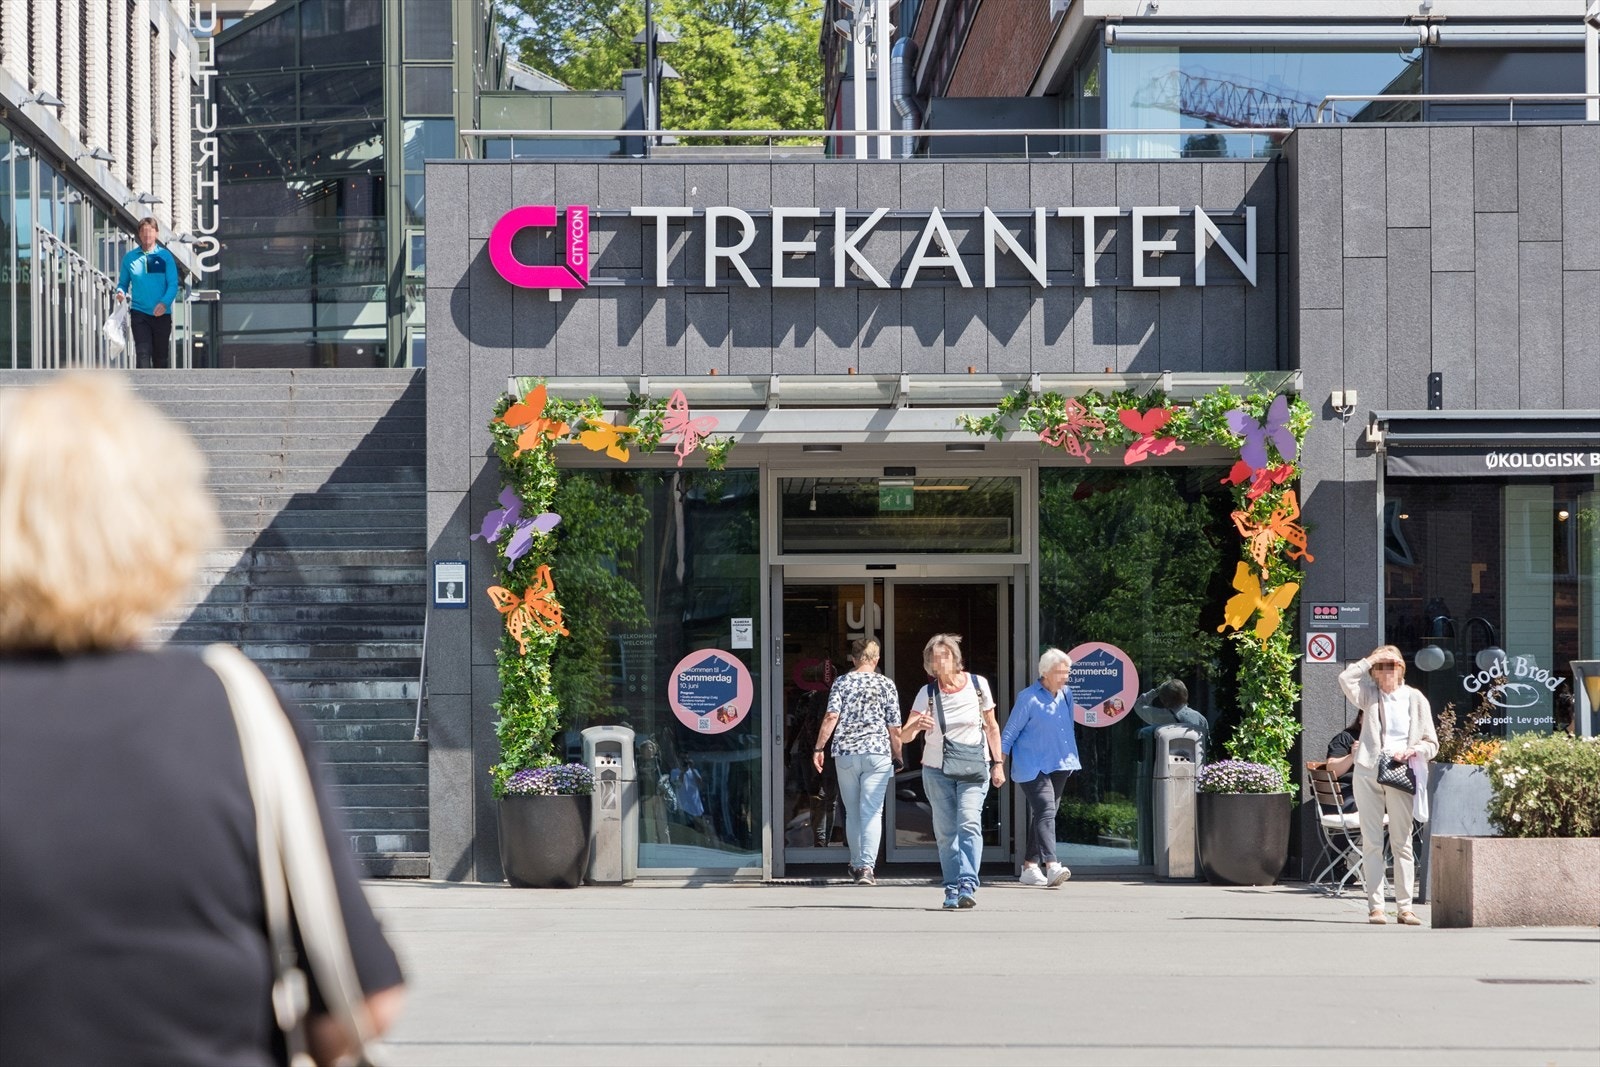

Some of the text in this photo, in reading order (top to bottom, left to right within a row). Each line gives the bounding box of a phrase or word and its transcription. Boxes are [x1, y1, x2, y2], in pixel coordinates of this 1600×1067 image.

[572, 209, 584, 266] CITYCON
[631, 205, 1257, 287] TREKANTEN
[1485, 451, 1586, 469] ØKOLOGISK
[680, 673, 732, 684] Sommerdag
[1463, 656, 1566, 693] Godt Brød
[1493, 716, 1513, 726] godt
[1533, 716, 1556, 725] godt.
